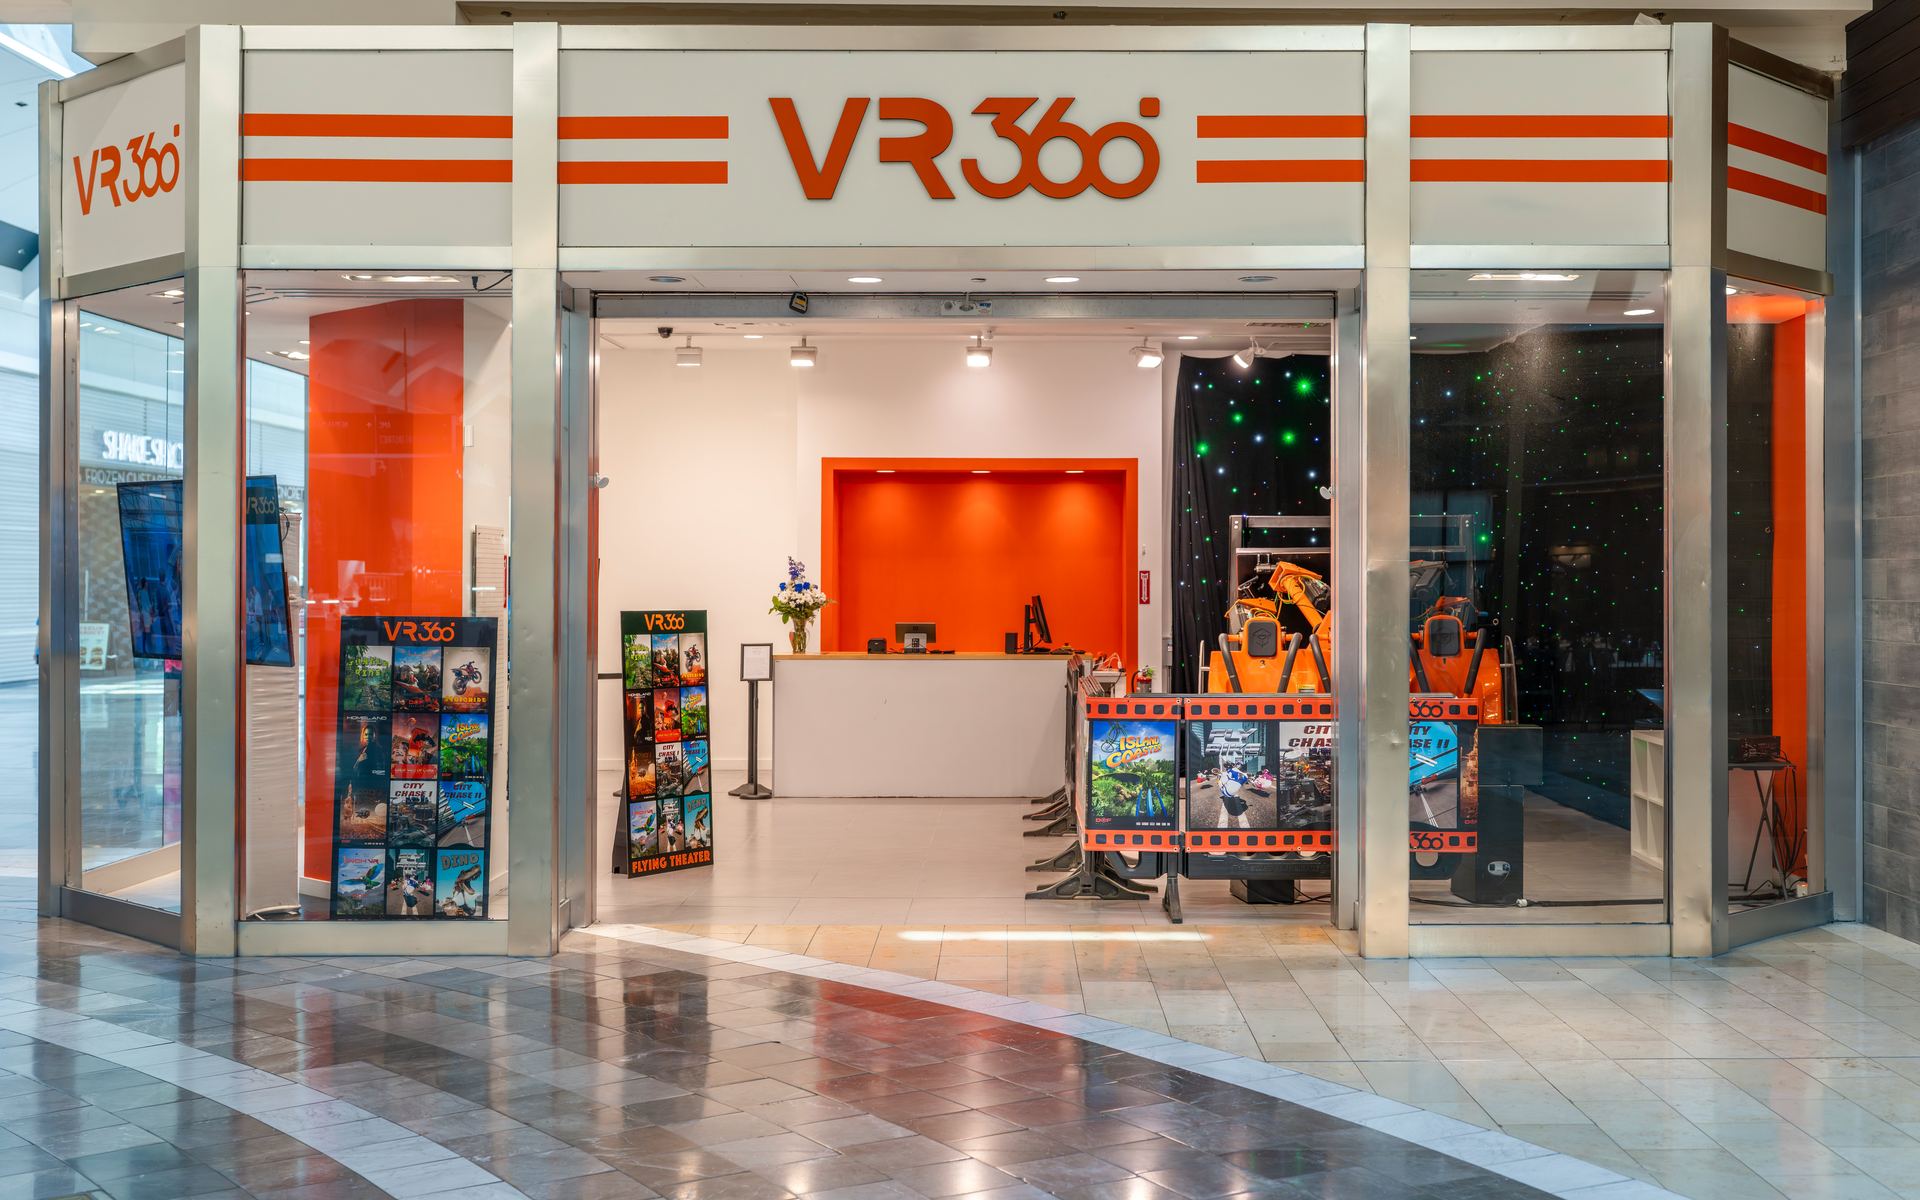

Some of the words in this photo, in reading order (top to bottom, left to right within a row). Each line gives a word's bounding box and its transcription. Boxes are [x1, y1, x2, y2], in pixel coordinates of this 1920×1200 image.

[102, 430, 152, 463] SHAKE
[151, 438, 184, 469] SHAC
[85, 468, 126, 485] FROZEN
[1208, 728, 1258, 742] FLY
[1303, 725, 1331, 735] CIT
[1119, 735, 1160, 751] ISLAND
[1288, 737, 1332, 748] CHAS
[1106, 743, 1163, 769] COASTER
[395, 790, 427, 798] CHASE
[441, 853, 480, 870] DINO
[632, 856, 667, 874] FLYING
[669, 850, 711, 868] THEATER
